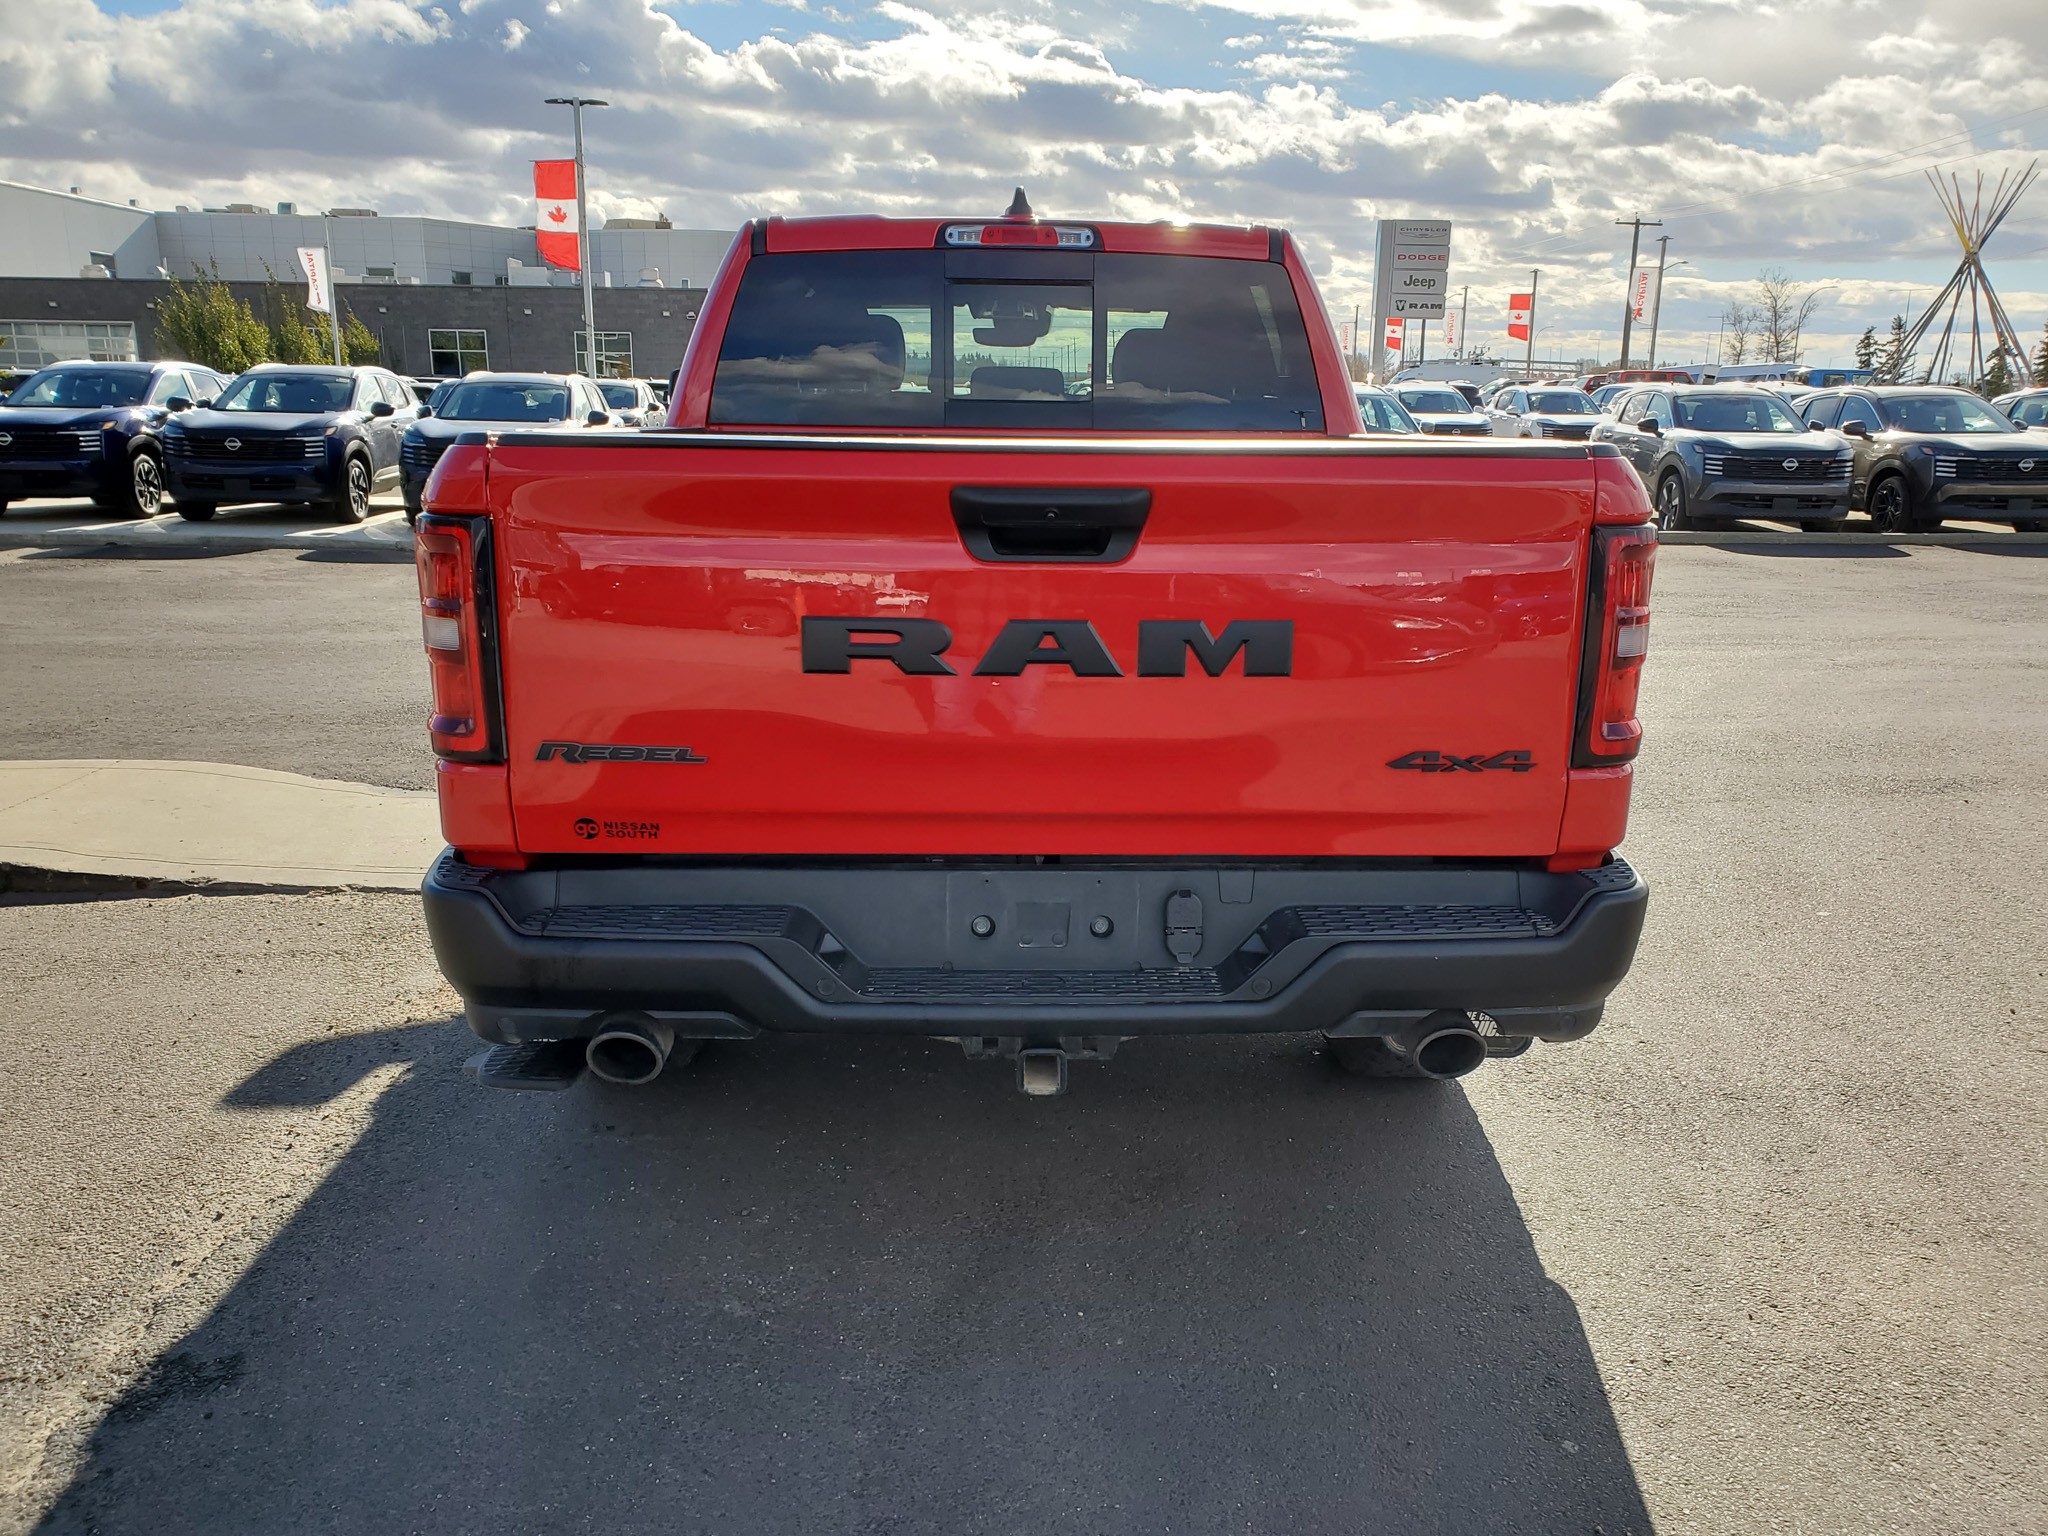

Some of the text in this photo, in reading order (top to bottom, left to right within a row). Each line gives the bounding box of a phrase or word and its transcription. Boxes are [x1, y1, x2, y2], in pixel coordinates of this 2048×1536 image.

[1403, 274, 1436, 289] Jeep
[801, 616, 1294, 677] RAM
[535, 740, 708, 764] REBEL
[1385, 750, 1538, 772] 4x4
[603, 821, 660, 831] NISSAN
[606, 830, 659, 839] SOUTH
